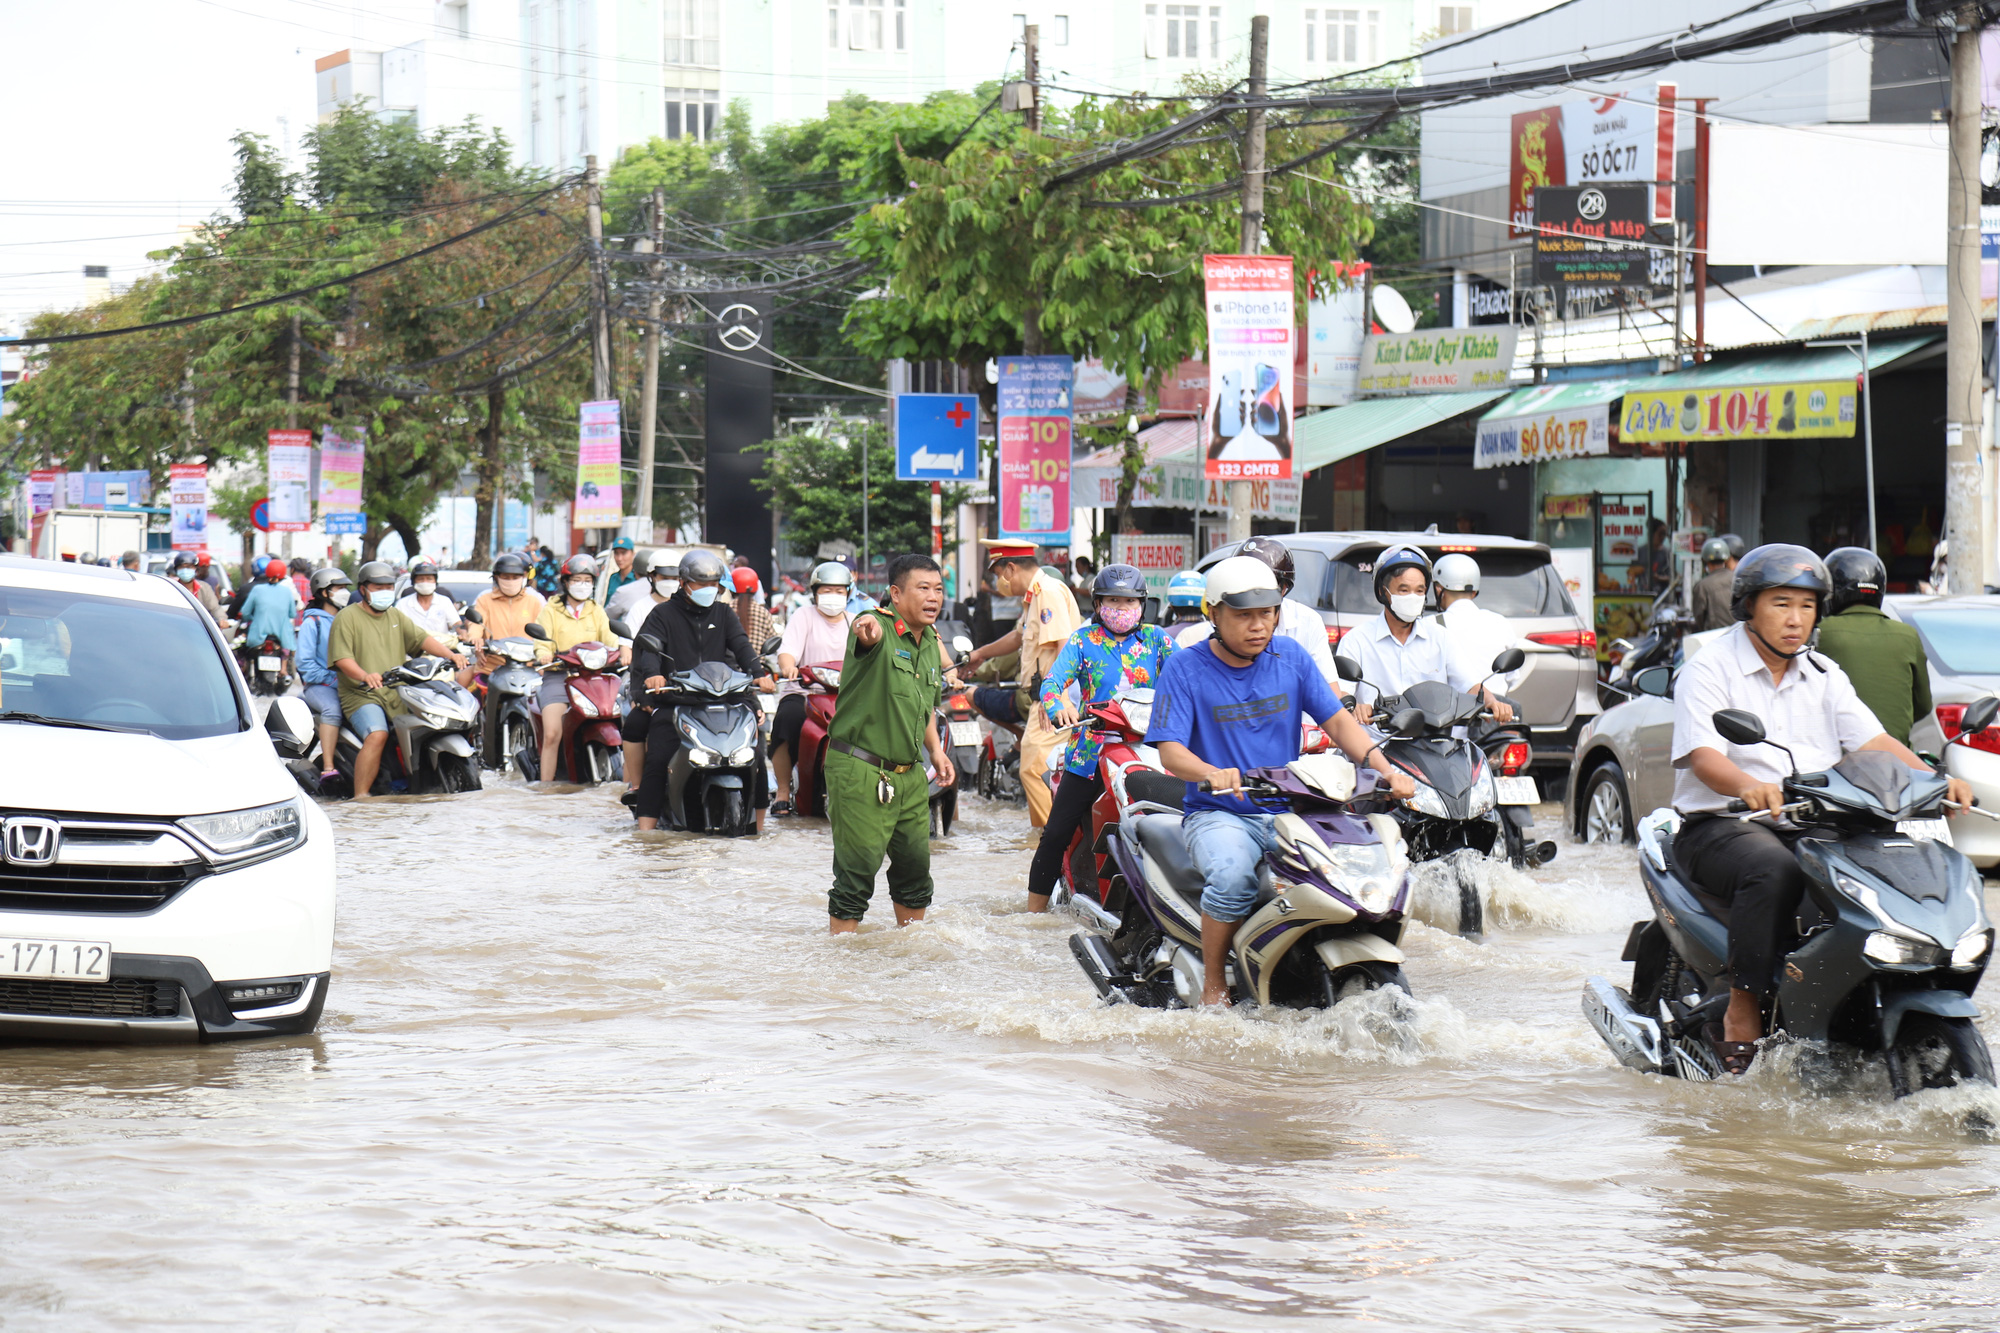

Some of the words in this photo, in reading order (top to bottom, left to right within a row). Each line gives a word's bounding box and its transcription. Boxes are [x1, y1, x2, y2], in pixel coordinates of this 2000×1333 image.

[1582, 145, 1599, 178] SÒ
[1603, 140, 1621, 174] ỐC
[1626, 146, 1637, 172] 77
[1539, 220, 1567, 237] Hai
[1573, 217, 1605, 238] Ông
[1610, 220, 1645, 240] Mập
[1225, 301, 1270, 314] iPhone
[1273, 301, 1287, 314] 14
[1374, 339, 1402, 365] Kính
[1405, 337, 1432, 362] Chào
[1434, 332, 1460, 366] Quý
[1460, 332, 1499, 361] Khách
[1022, 372, 1045, 380] LONG
[1421, 374, 1457, 386] KHANG
[1015, 395, 1026, 408] 2
[1626, 400, 1644, 434] Cà
[1648, 399, 1675, 433] Phê
[1702, 388, 1772, 436] 104
[1521, 421, 1539, 457] SÒ
[1544, 416, 1565, 454] ỐC
[1569, 421, 1587, 450] 77
[1218, 463, 1241, 476] 133
[1243, 463, 1279, 475] CMT8
[1208, 480, 1218, 504] A
[1604, 523, 1621, 536] XÍU
[1624, 525, 1643, 539] MẠI
[1126, 546, 1134, 566] A
[1138, 546, 1183, 568] KHANG
